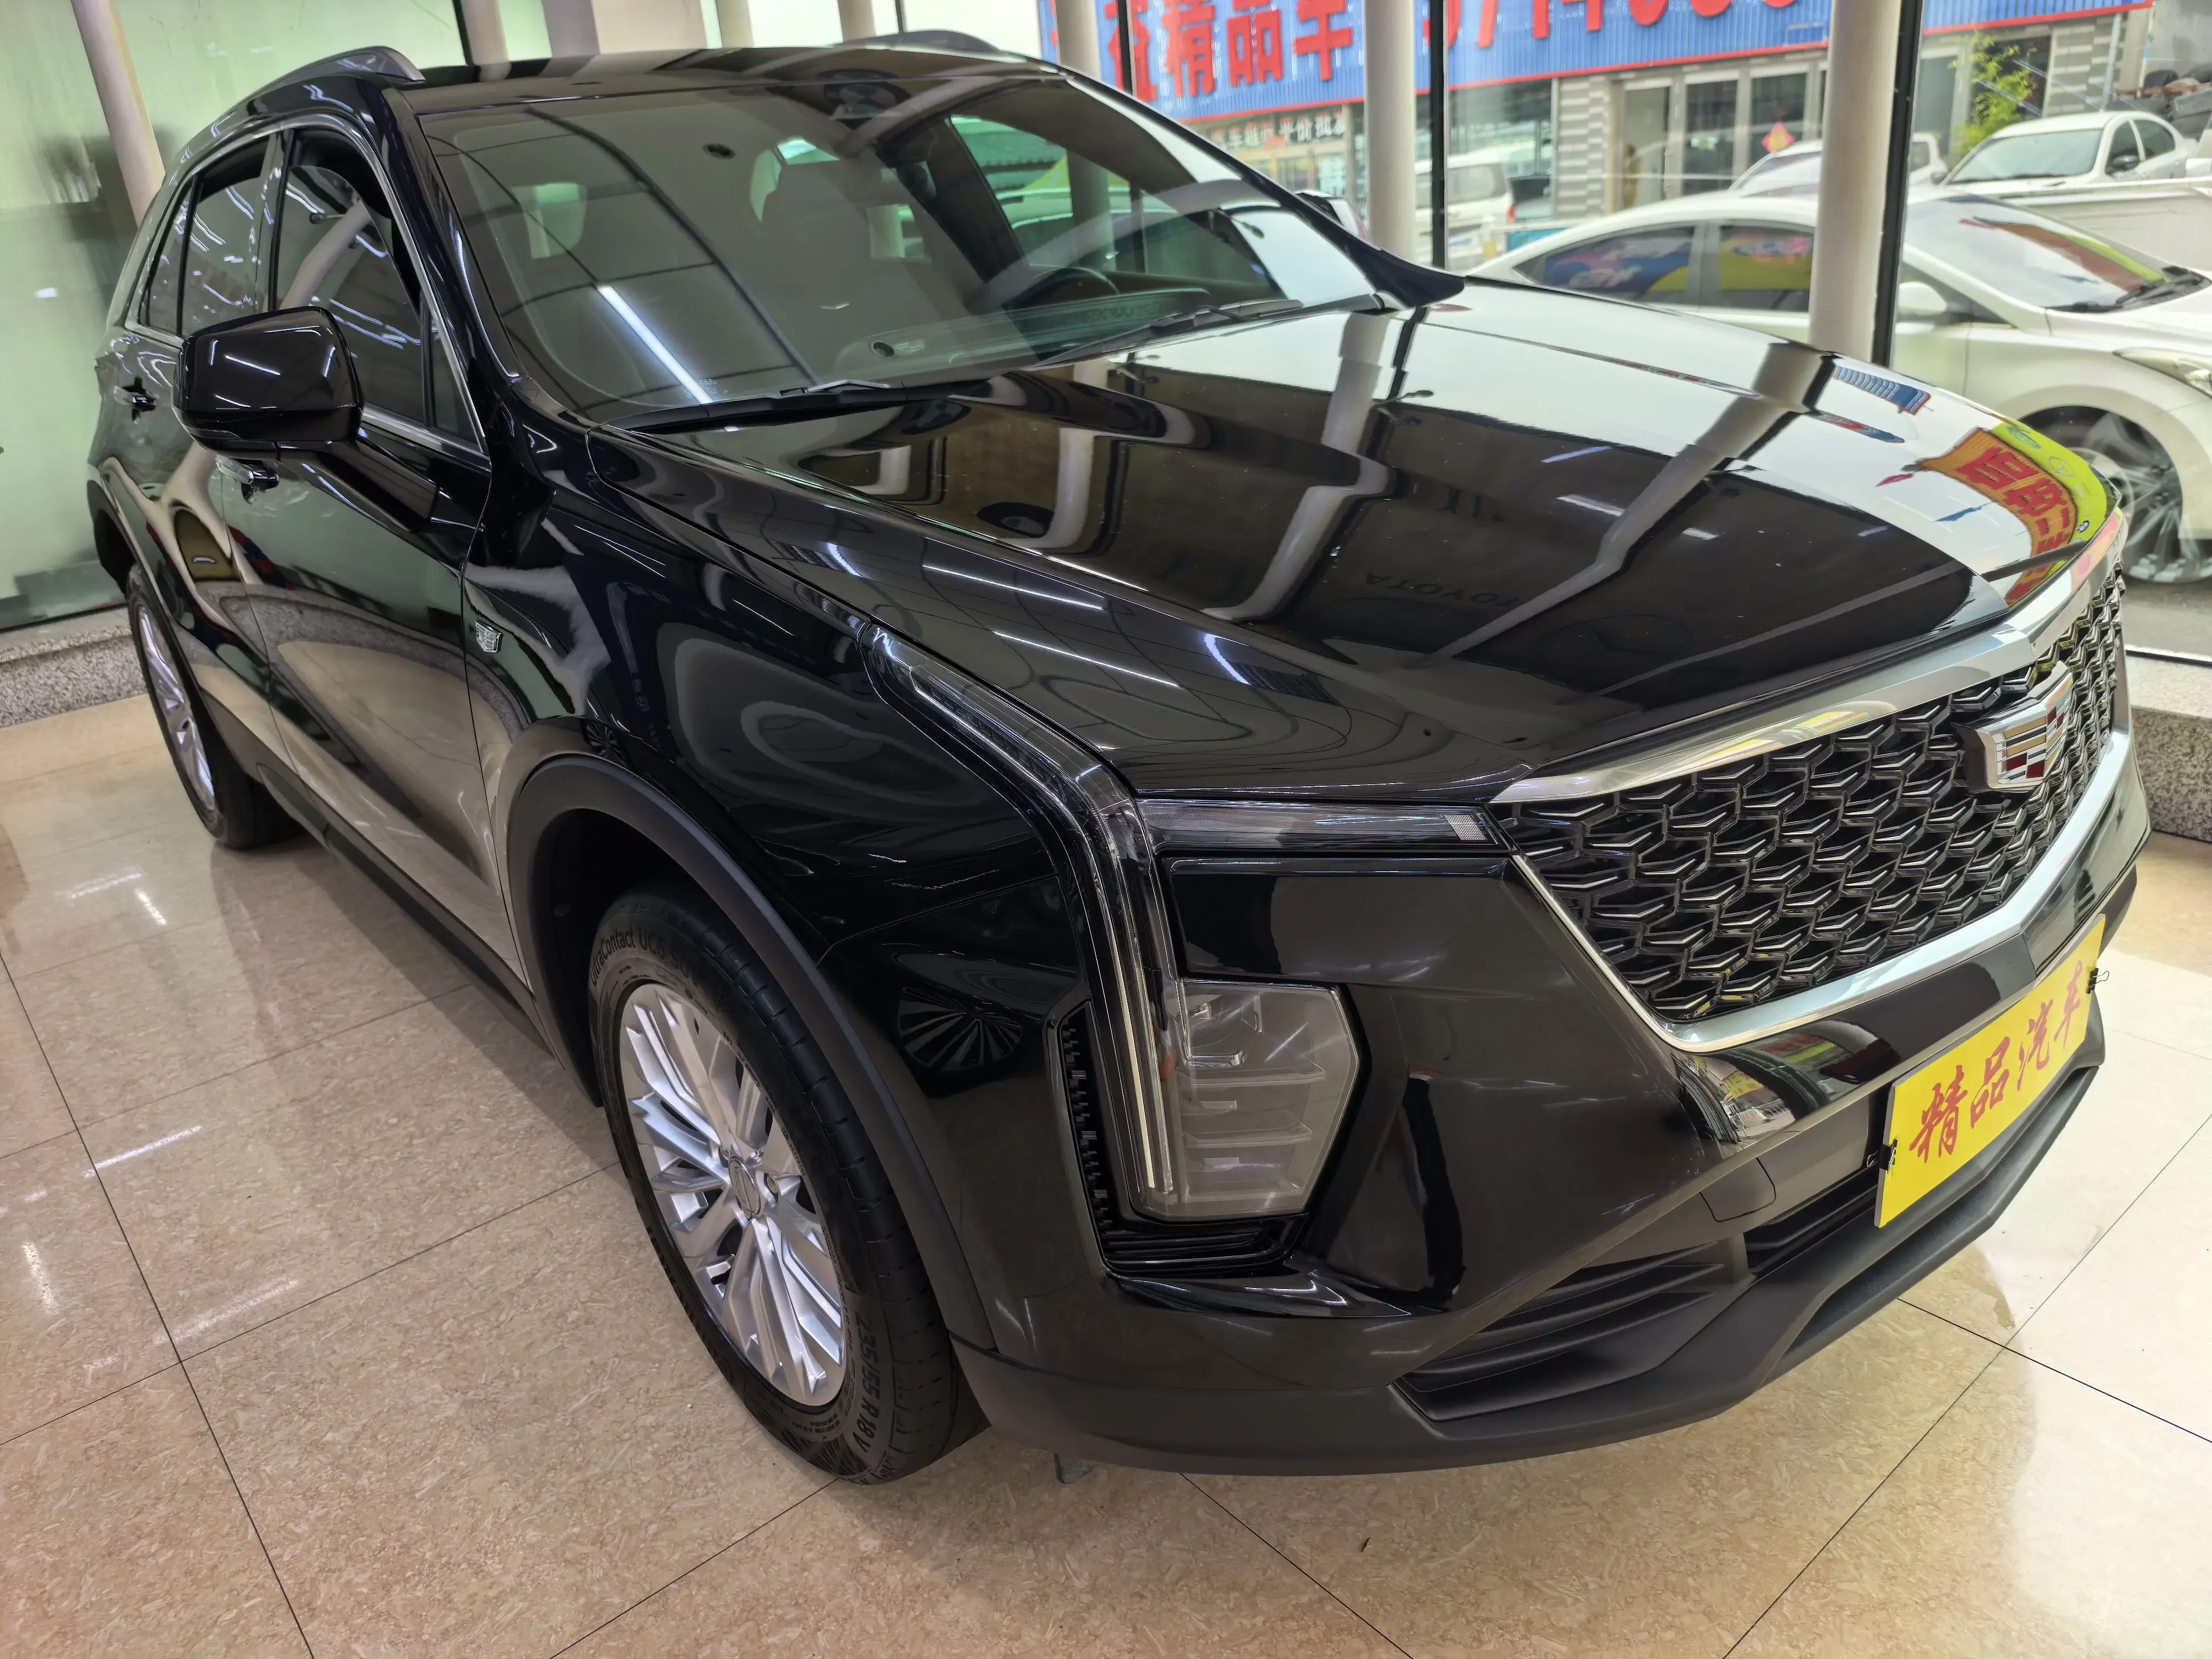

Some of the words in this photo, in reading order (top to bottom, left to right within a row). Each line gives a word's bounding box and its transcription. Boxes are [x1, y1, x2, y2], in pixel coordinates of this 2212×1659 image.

[590, 926, 636, 987] UltraContact
[1908, 961, 2082, 1163] 精品汽车
[855, 1313, 881, 1399] 235/55
